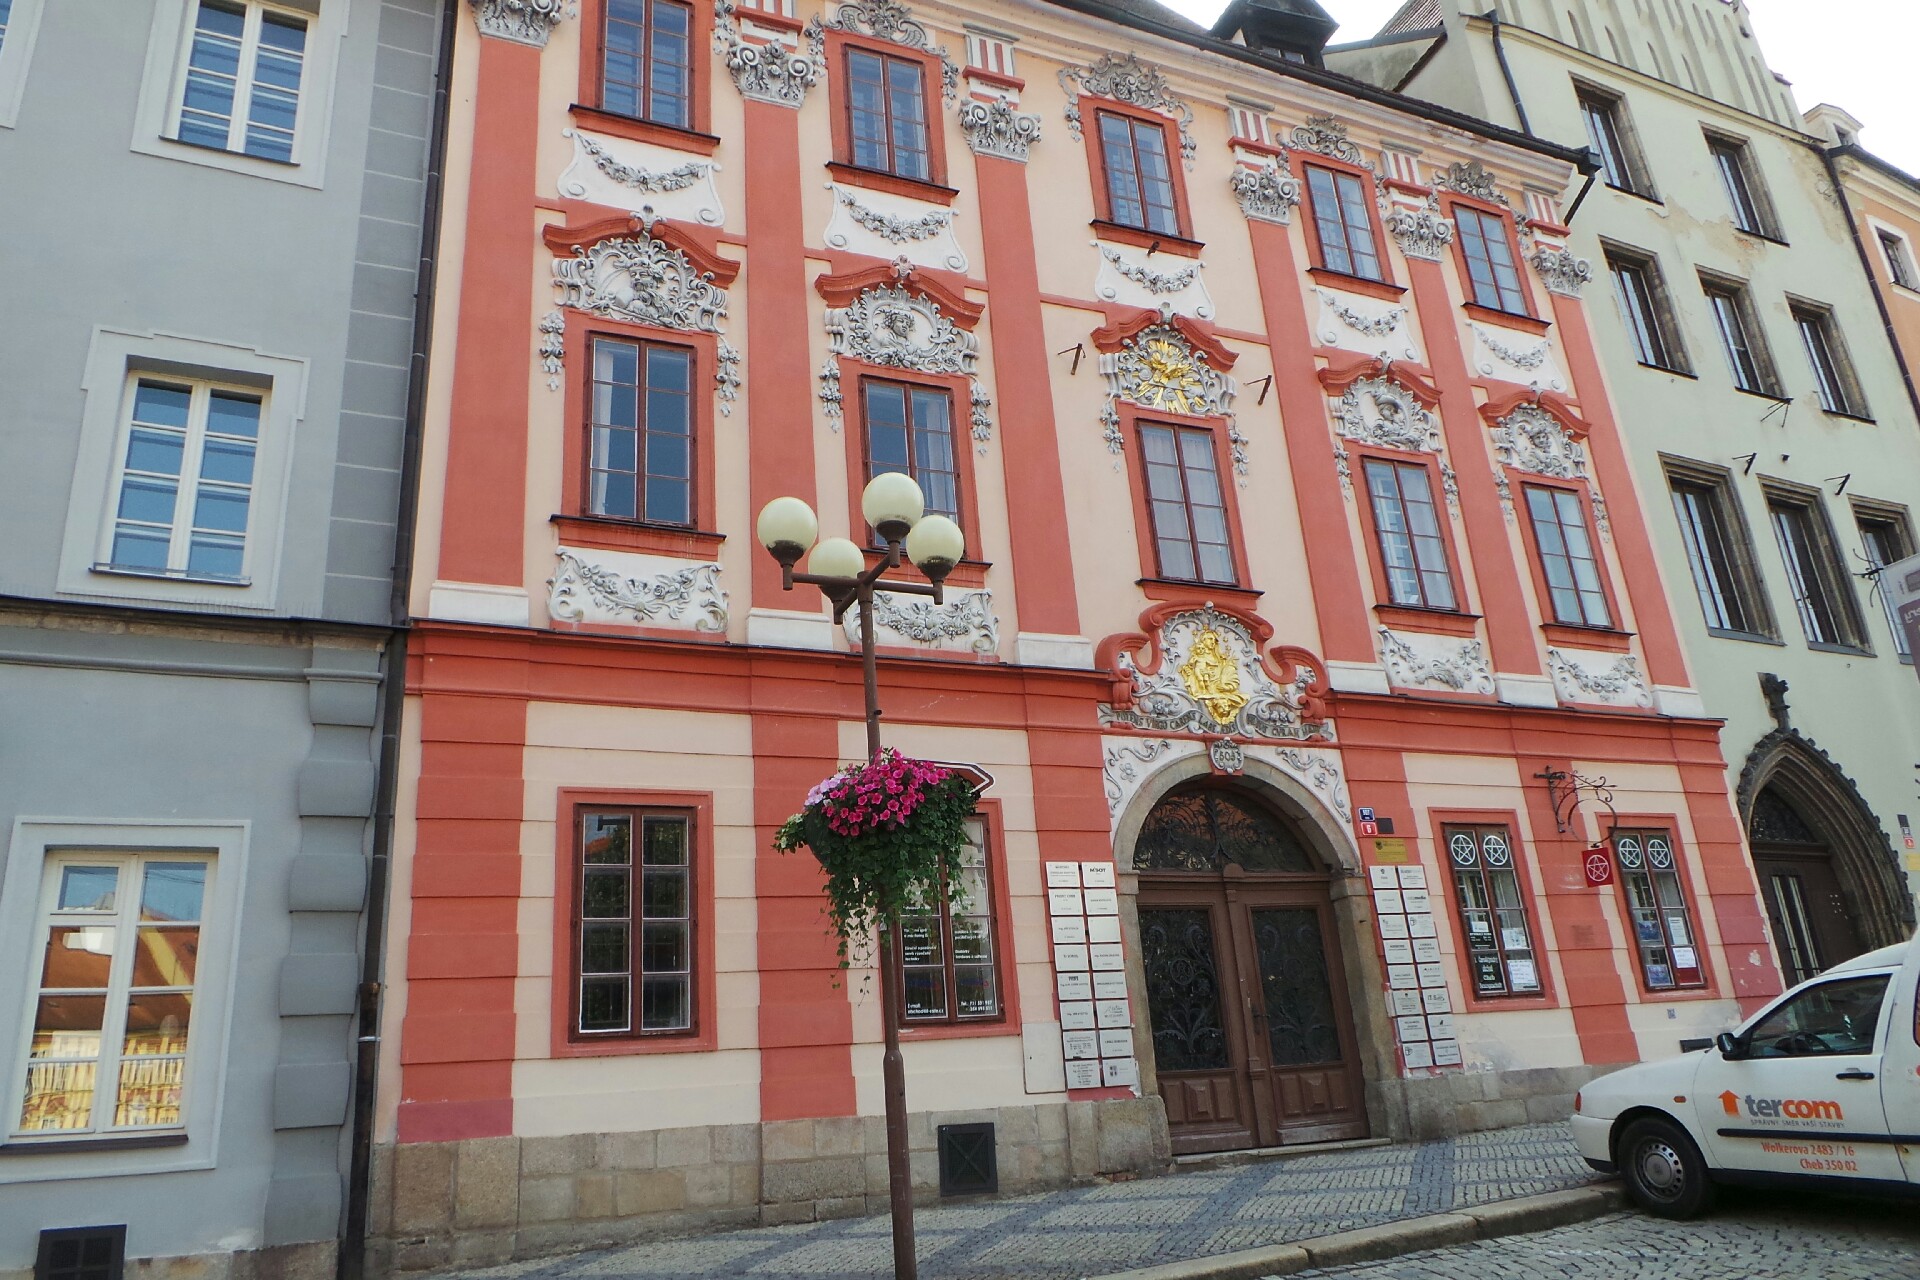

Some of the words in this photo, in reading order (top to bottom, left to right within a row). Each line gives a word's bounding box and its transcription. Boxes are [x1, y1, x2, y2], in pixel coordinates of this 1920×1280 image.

[1744, 1094, 1844, 1120] tercom
[1761, 1142, 1809, 1154] Wolkerova
[1811, 1144, 1834, 1155] 2483
[1841, 1145, 1855, 1156] 16
[1800, 1158, 1824, 1169] Cheb
[1825, 1159, 1844, 1171] 350
[1844, 1160, 1858, 1171] 02
